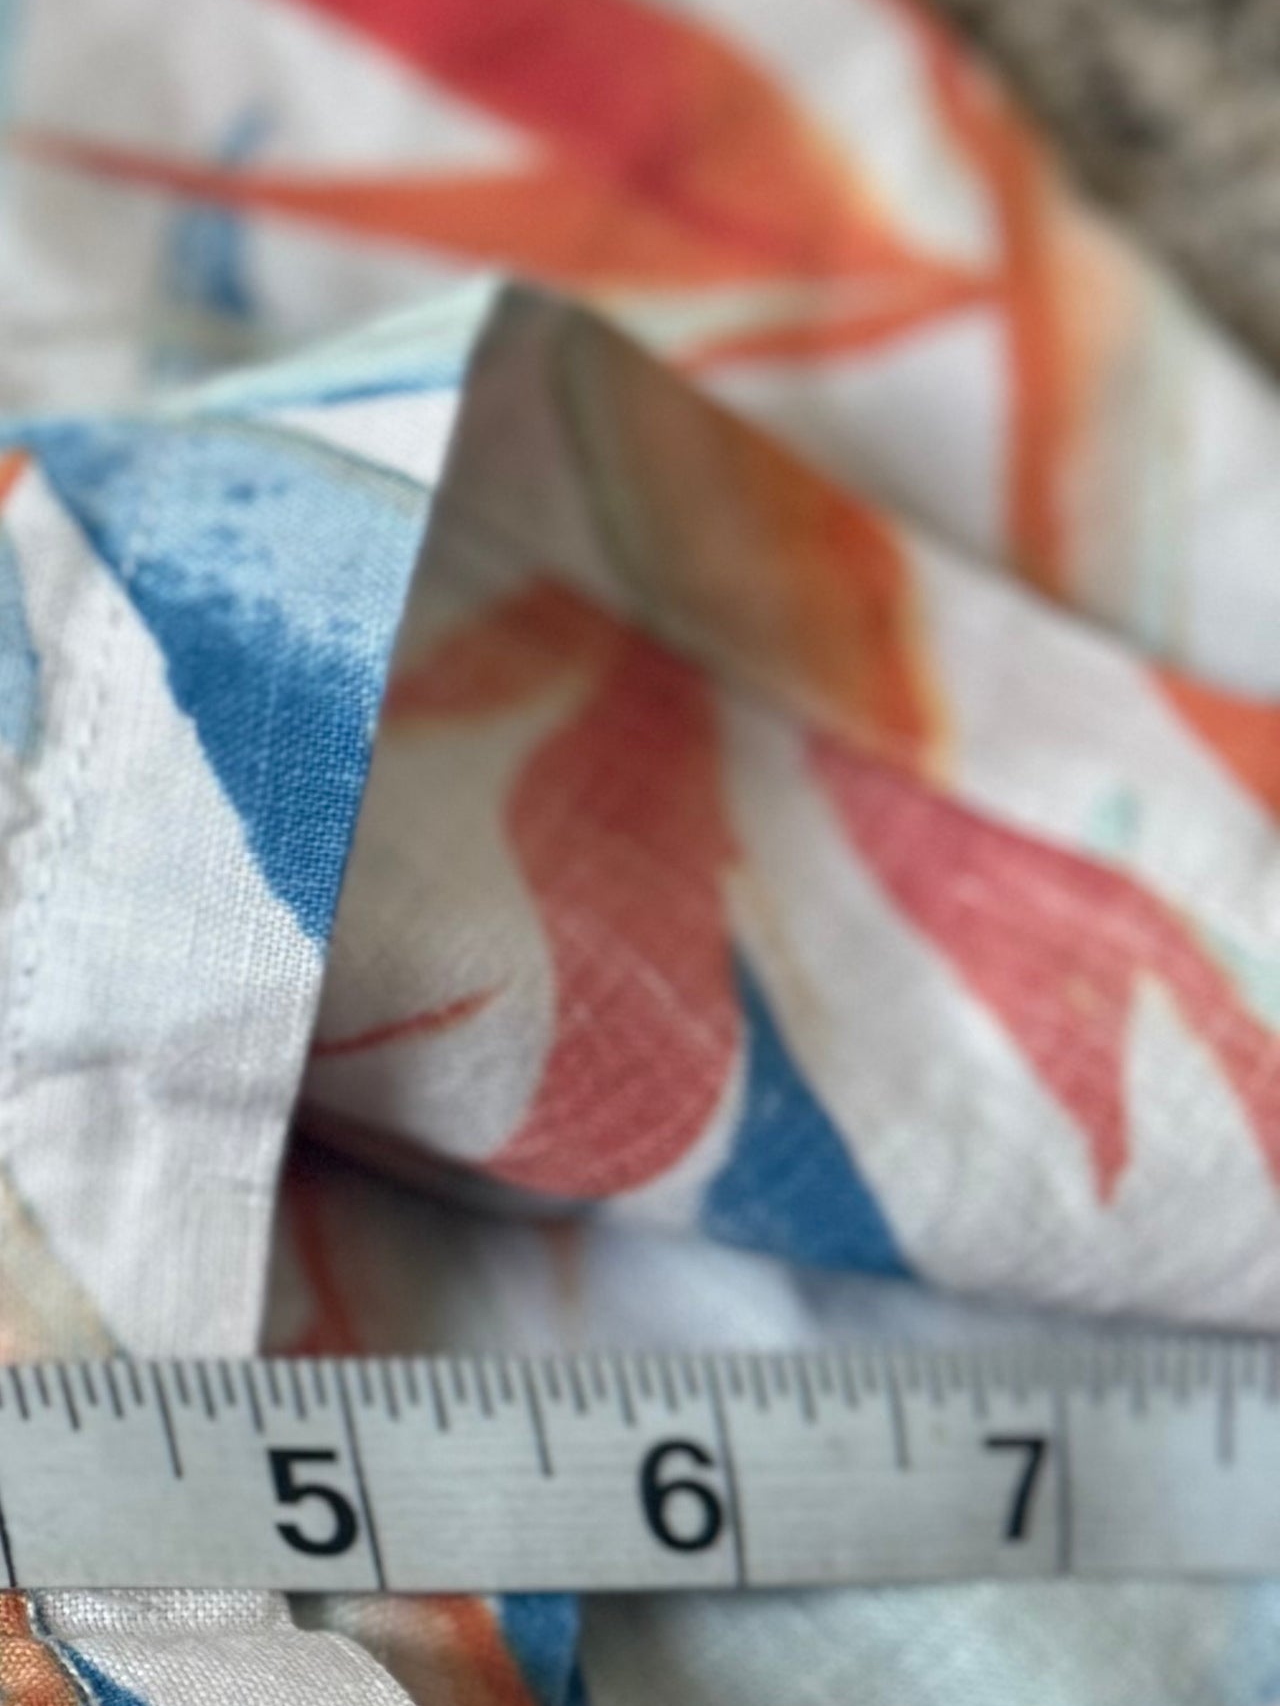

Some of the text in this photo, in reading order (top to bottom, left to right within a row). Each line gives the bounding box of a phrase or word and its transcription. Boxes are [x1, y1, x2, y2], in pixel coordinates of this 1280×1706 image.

[266, 1447, 359, 1557] 5
[638, 1437, 725, 1553] 6
[983, 1435, 1046, 1542] 7
